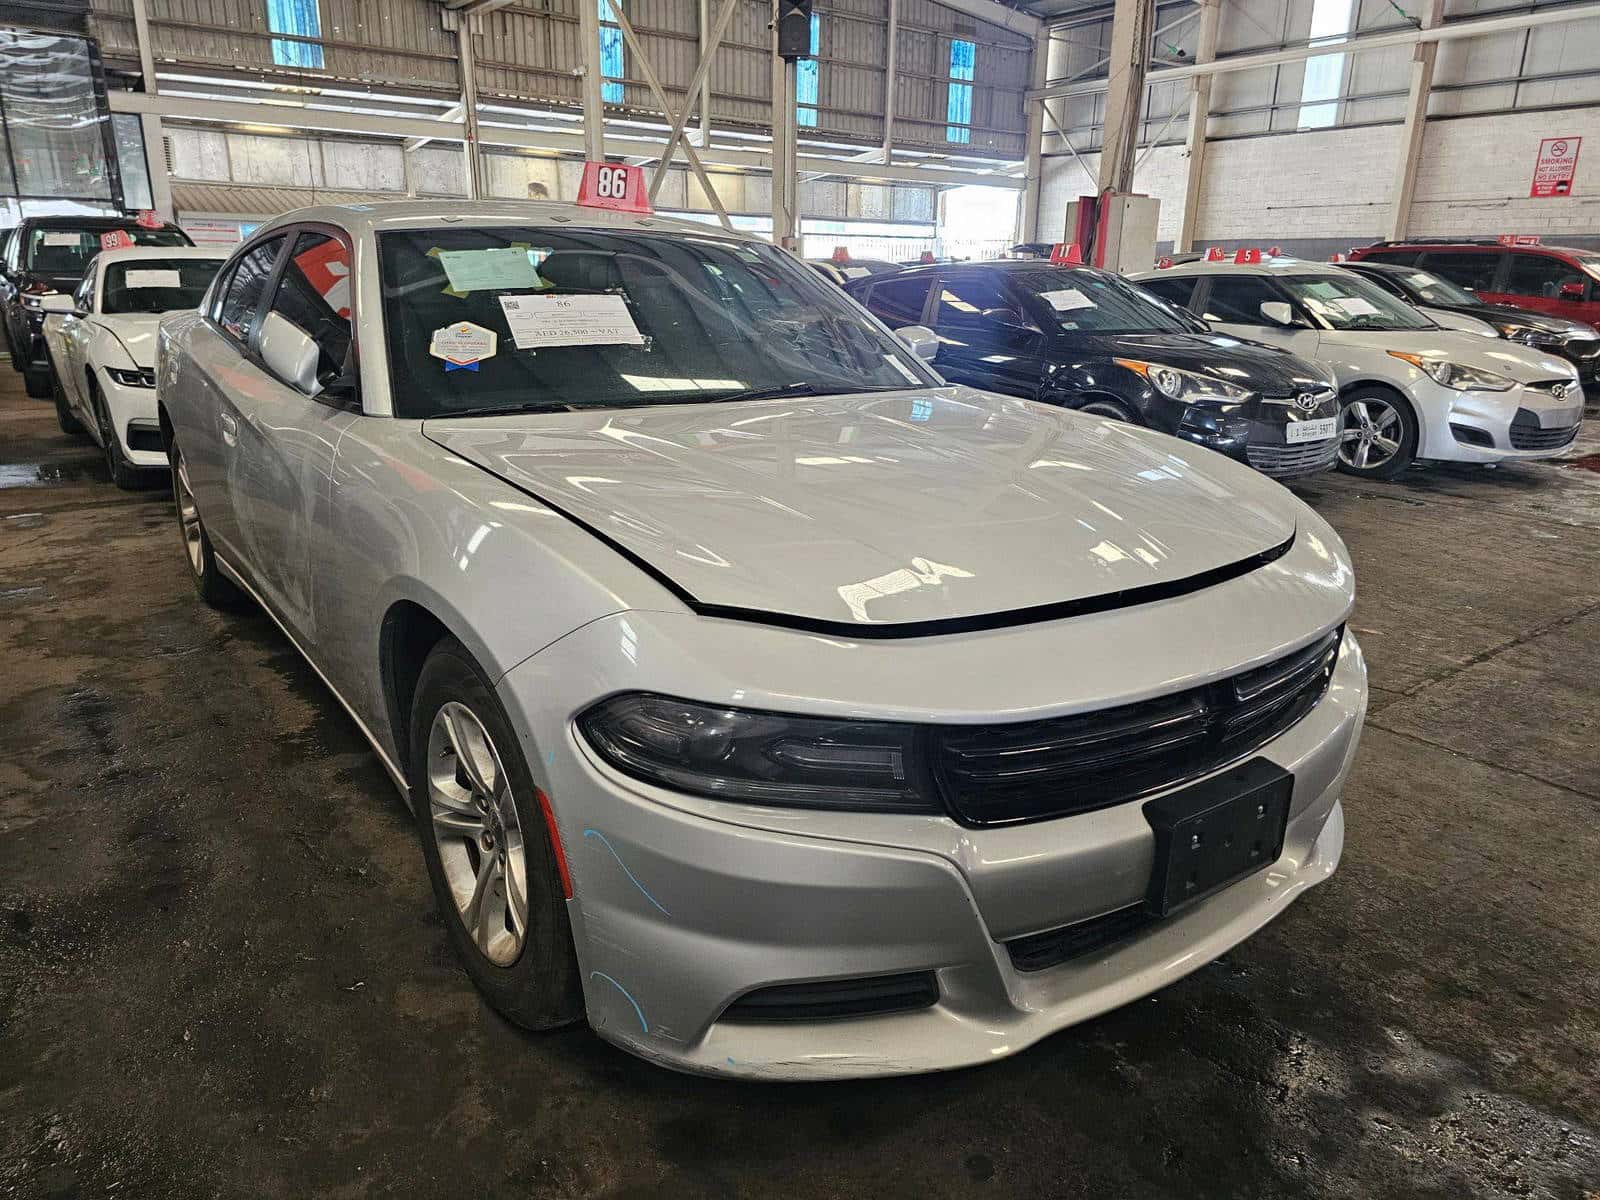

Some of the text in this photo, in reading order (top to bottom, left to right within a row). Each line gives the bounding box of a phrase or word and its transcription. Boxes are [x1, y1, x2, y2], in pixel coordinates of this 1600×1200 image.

[1540, 157, 1573, 165] SMOKING
[598, 166, 627, 199] 86
[1245, 249, 1252, 261] 5
[535, 329, 557, 337] AED
[598, 327, 620, 336] VAT
